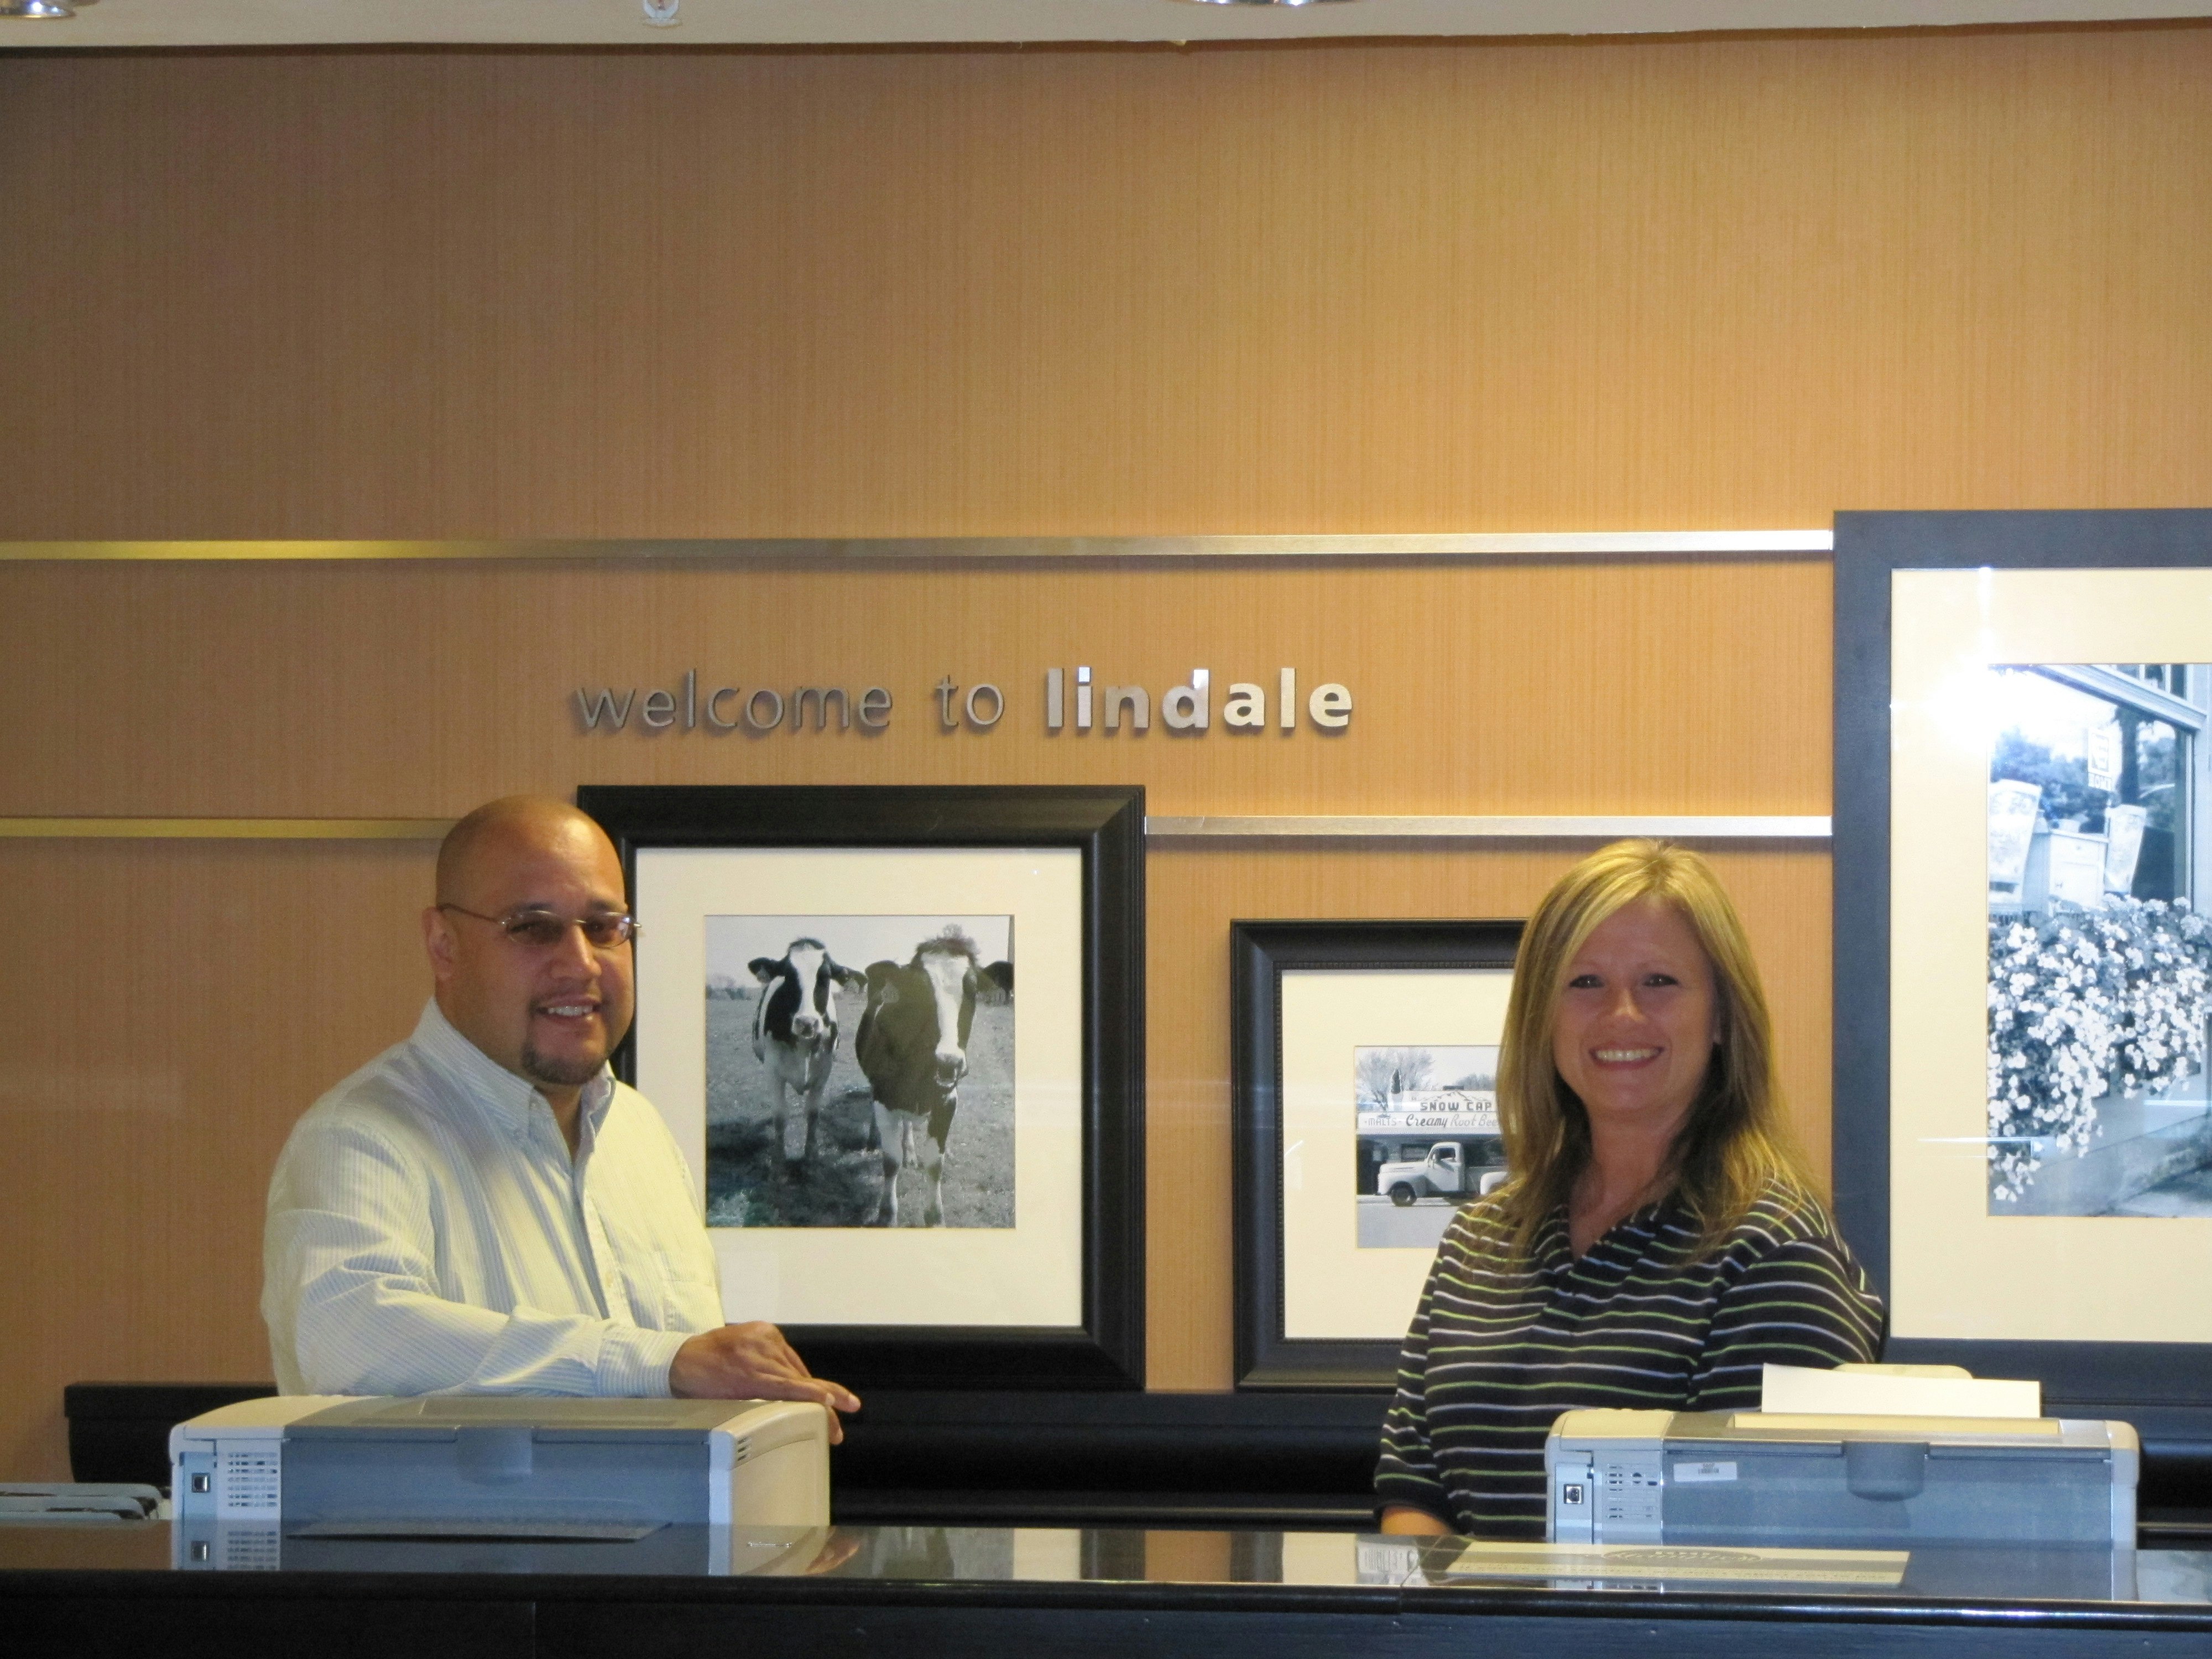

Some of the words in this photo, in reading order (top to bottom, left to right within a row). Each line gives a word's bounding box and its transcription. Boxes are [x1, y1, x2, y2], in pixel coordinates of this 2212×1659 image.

[577, 667, 893, 728] welcome
[935, 675, 1005, 727] to
[1048, 667, 1353, 728] lindale
[1420, 1102, 1459, 1111] SNOW
[1467, 1101, 1492, 1111] CAP
[1368, 1118, 1397, 1126] MALTS
[1406, 1114, 1448, 1128] Creamy
[1450, 1113, 1477, 1126] Root
[1478, 1113, 1498, 1126] Bee
